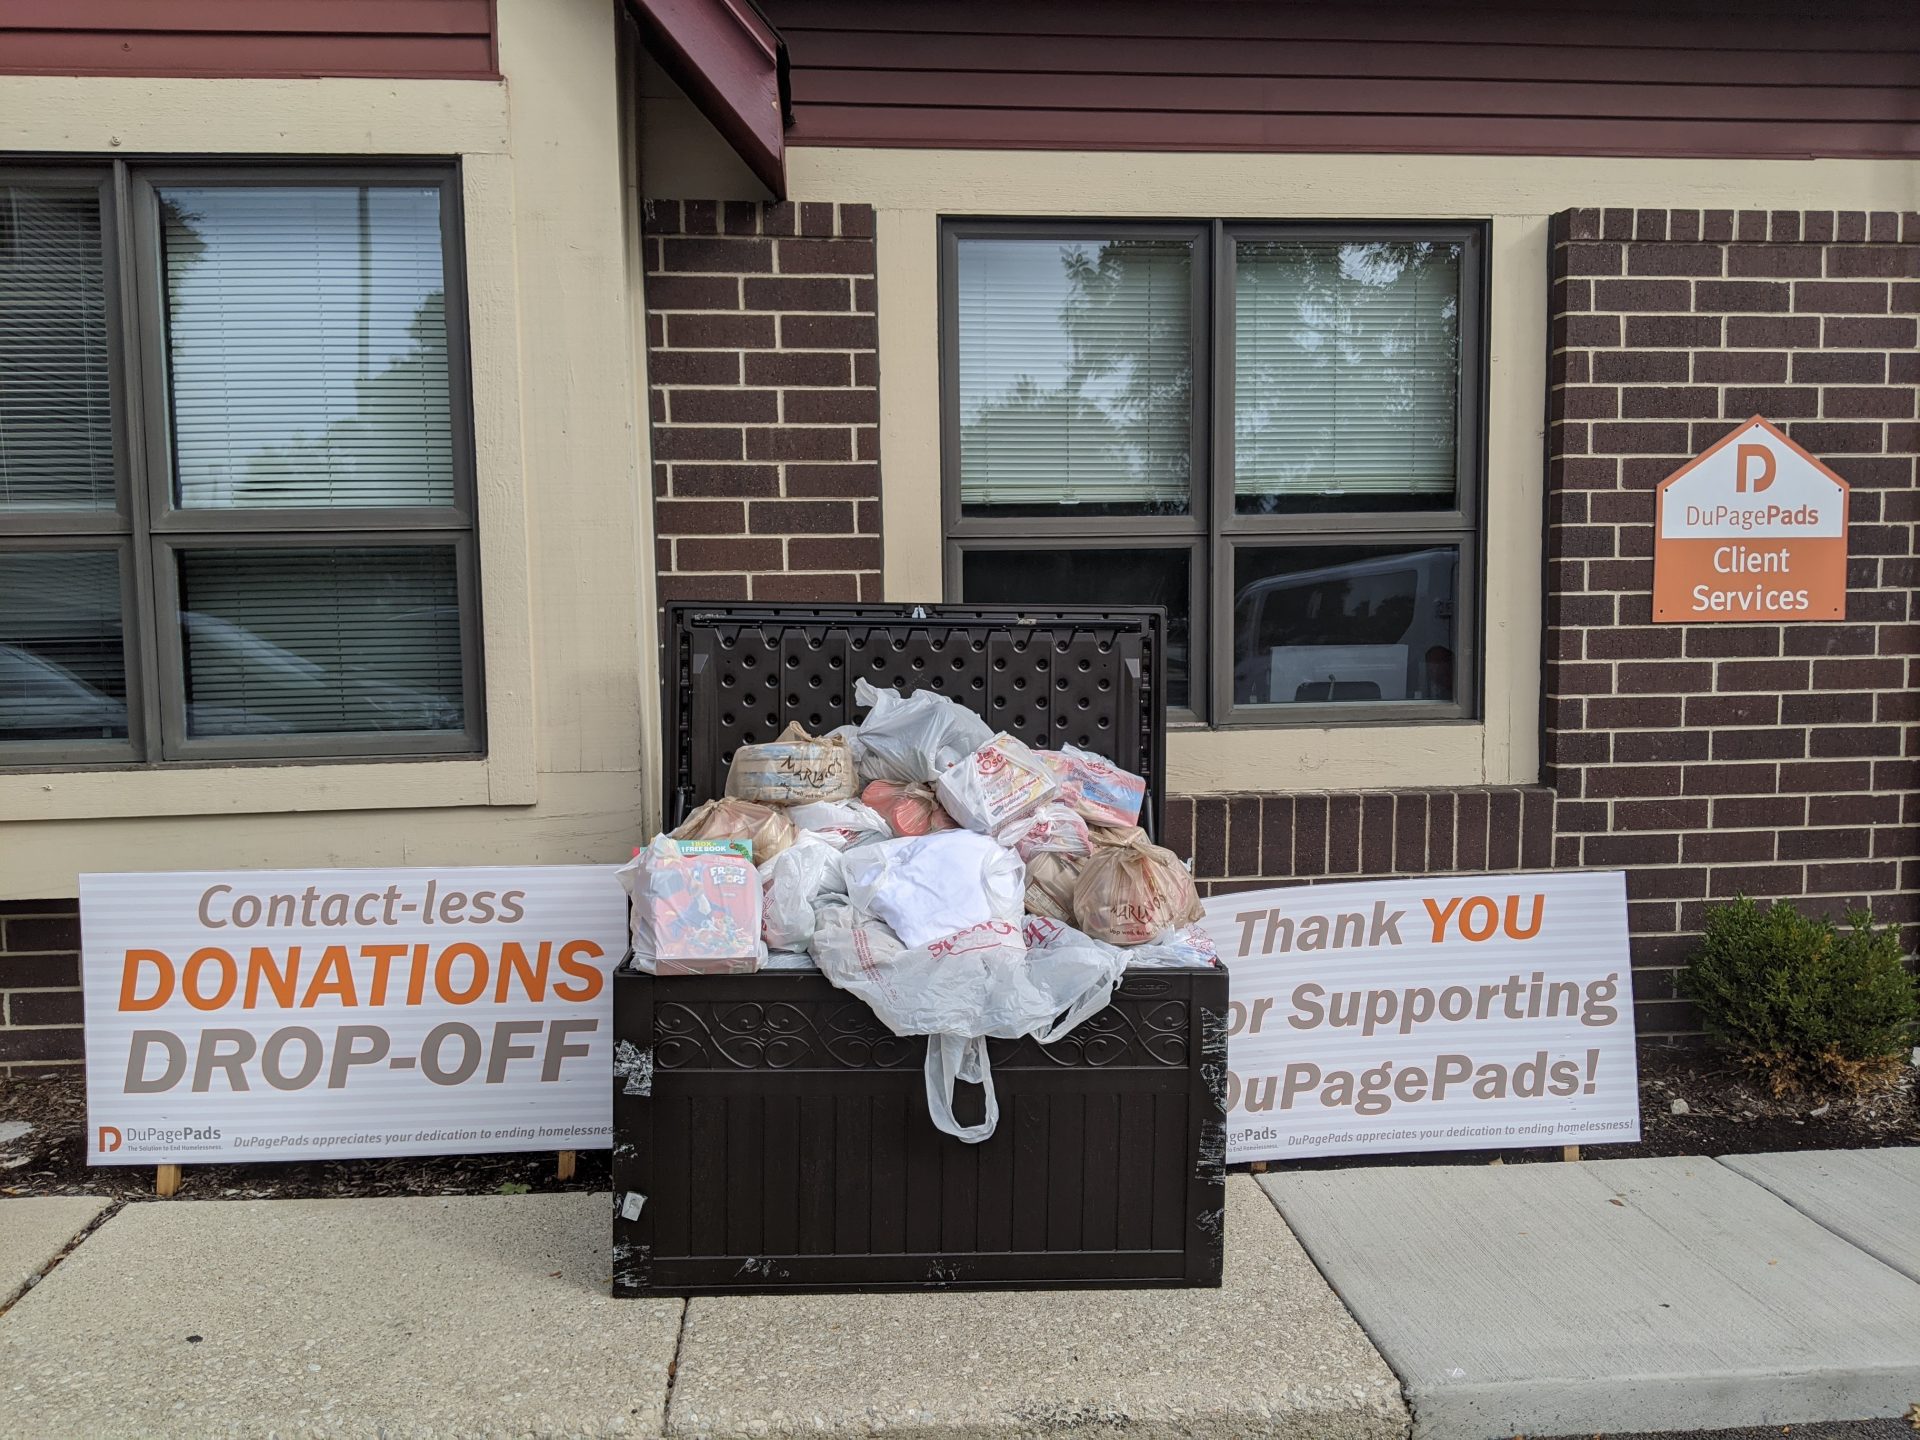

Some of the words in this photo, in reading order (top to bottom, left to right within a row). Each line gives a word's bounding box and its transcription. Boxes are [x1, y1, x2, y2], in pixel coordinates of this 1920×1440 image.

[1686, 504, 1819, 530] DuPagePads
[1713, 545, 1790, 573] Client
[1692, 584, 1809, 611] Services
[197, 879, 526, 929] Contact-less
[1235, 900, 1407, 957] Thank
[1422, 894, 1545, 943] YOU
[118, 939, 605, 1012] DONATIONS
[1228, 995, 1273, 1037] or
[1287, 971, 1619, 1037] Supporting
[122, 1018, 599, 1094] DROP-OFF
[127, 1125, 222, 1143] DuPagePads
[234, 1135, 309, 1149] DuPagePads
[312, 1133, 382, 1147] appreciates
[385, 1133, 413, 1145] your
[415, 1129, 477, 1142] dedication
[480, 1129, 492, 1139] to
[495, 1126, 535, 1140] ending
[538, 1125, 613, 1137] homelessnes
[1226, 1127, 1277, 1146] gePads
[1288, 1133, 1353, 1147] DuPagePads
[1356, 1129, 1417, 1143] appreciates
[1419, 1128, 1445, 1140] your
[1446, 1125, 1502, 1138] dedication
[1504, 1125, 1515, 1135] to
[1518, 1123, 1554, 1136] ending
[1556, 1119, 1634, 1133] homelessness!
